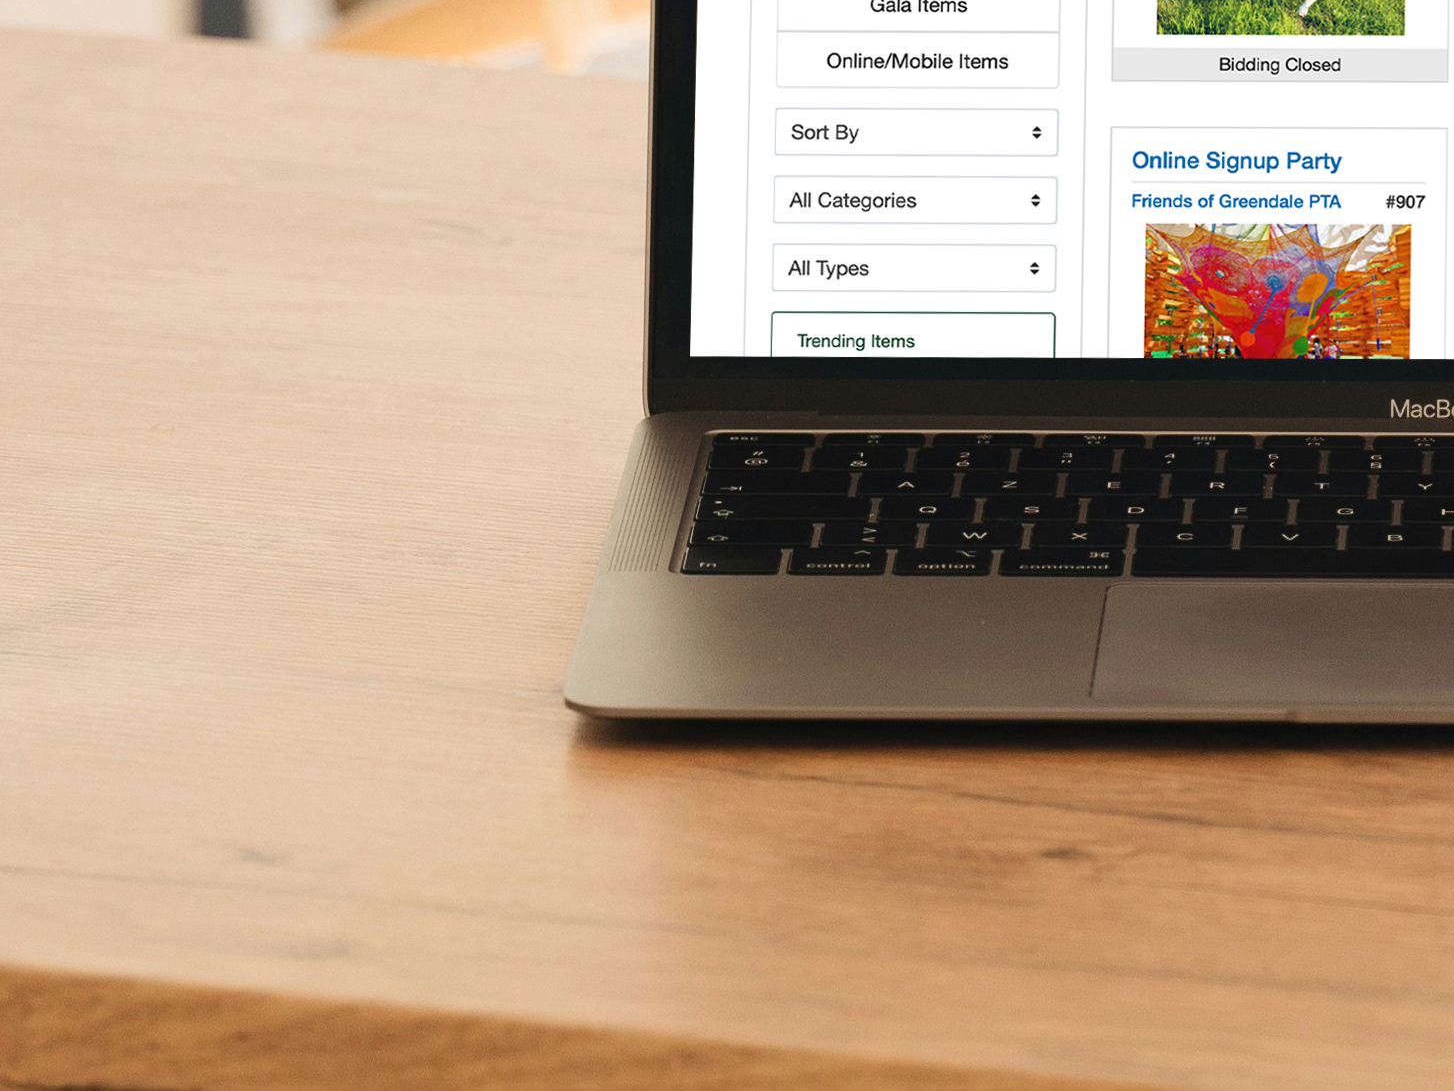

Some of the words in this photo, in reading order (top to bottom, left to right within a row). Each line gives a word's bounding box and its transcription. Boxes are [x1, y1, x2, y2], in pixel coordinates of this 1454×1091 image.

[827, 53, 953, 69] Online/Mobile
[960, 54, 1008, 69] Items
[1220, 57, 1279, 75] Bidding
[1286, 57, 1341, 71] Closed
[792, 124, 829, 140] Sort
[836, 125, 859, 144] By
[1132, 151, 1199, 169] Online
[1206, 151, 1279, 173] Signup
[1287, 152, 1342, 174] Party
[789, 192, 811, 207] All
[818, 192, 917, 212] Categories
[1132, 194, 1192, 208] Friends
[1198, 194, 1214, 208] of
[1219, 194, 1304, 208] Greendale
[1310, 195, 1341, 208] PTA
[1386, 195, 1425, 209] #907
[788, 260, 810, 275] All
[816, 260, 869, 280] Types
[797, 334, 865, 351] Trending
[872, 334, 915, 348] Items
